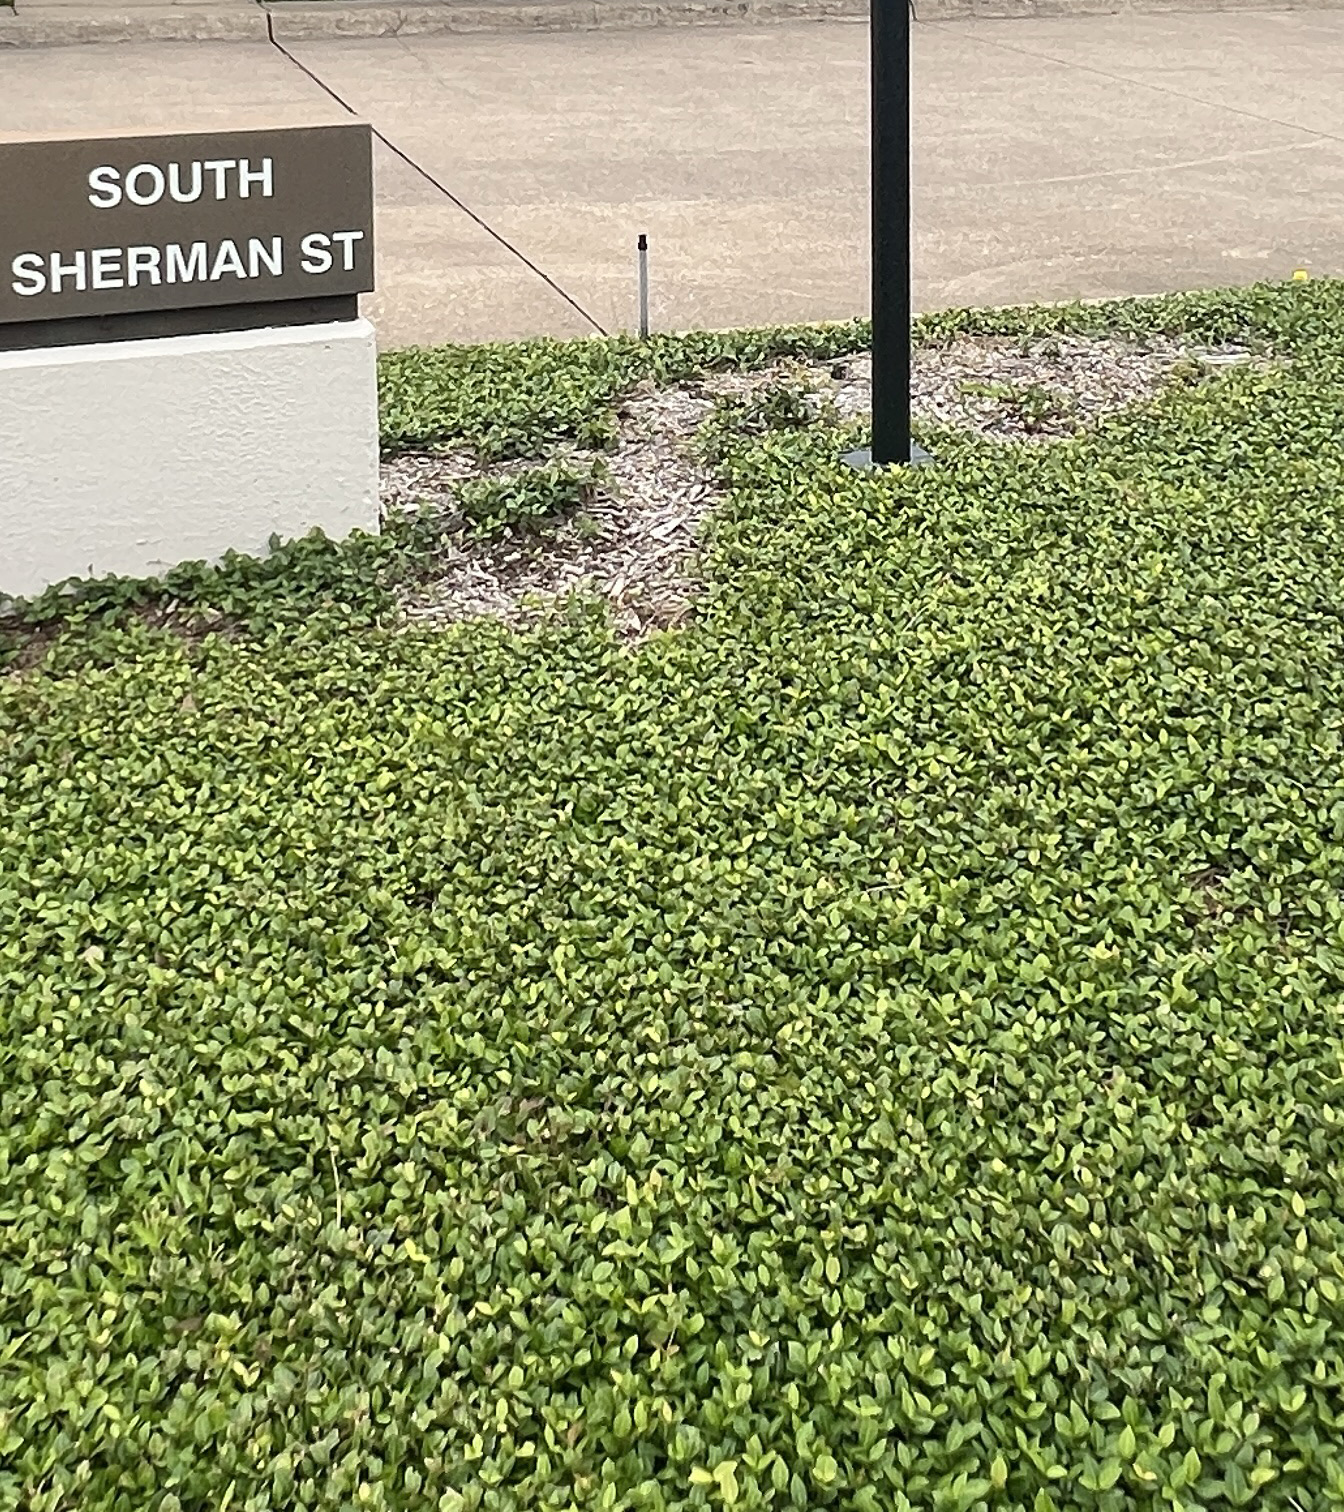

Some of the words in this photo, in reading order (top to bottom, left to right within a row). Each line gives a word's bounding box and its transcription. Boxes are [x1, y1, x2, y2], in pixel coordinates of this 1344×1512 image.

[86, 157, 275, 210] SOUTH
[9, 236, 285, 298] SHERMAN
[299, 230, 365, 276] ST
